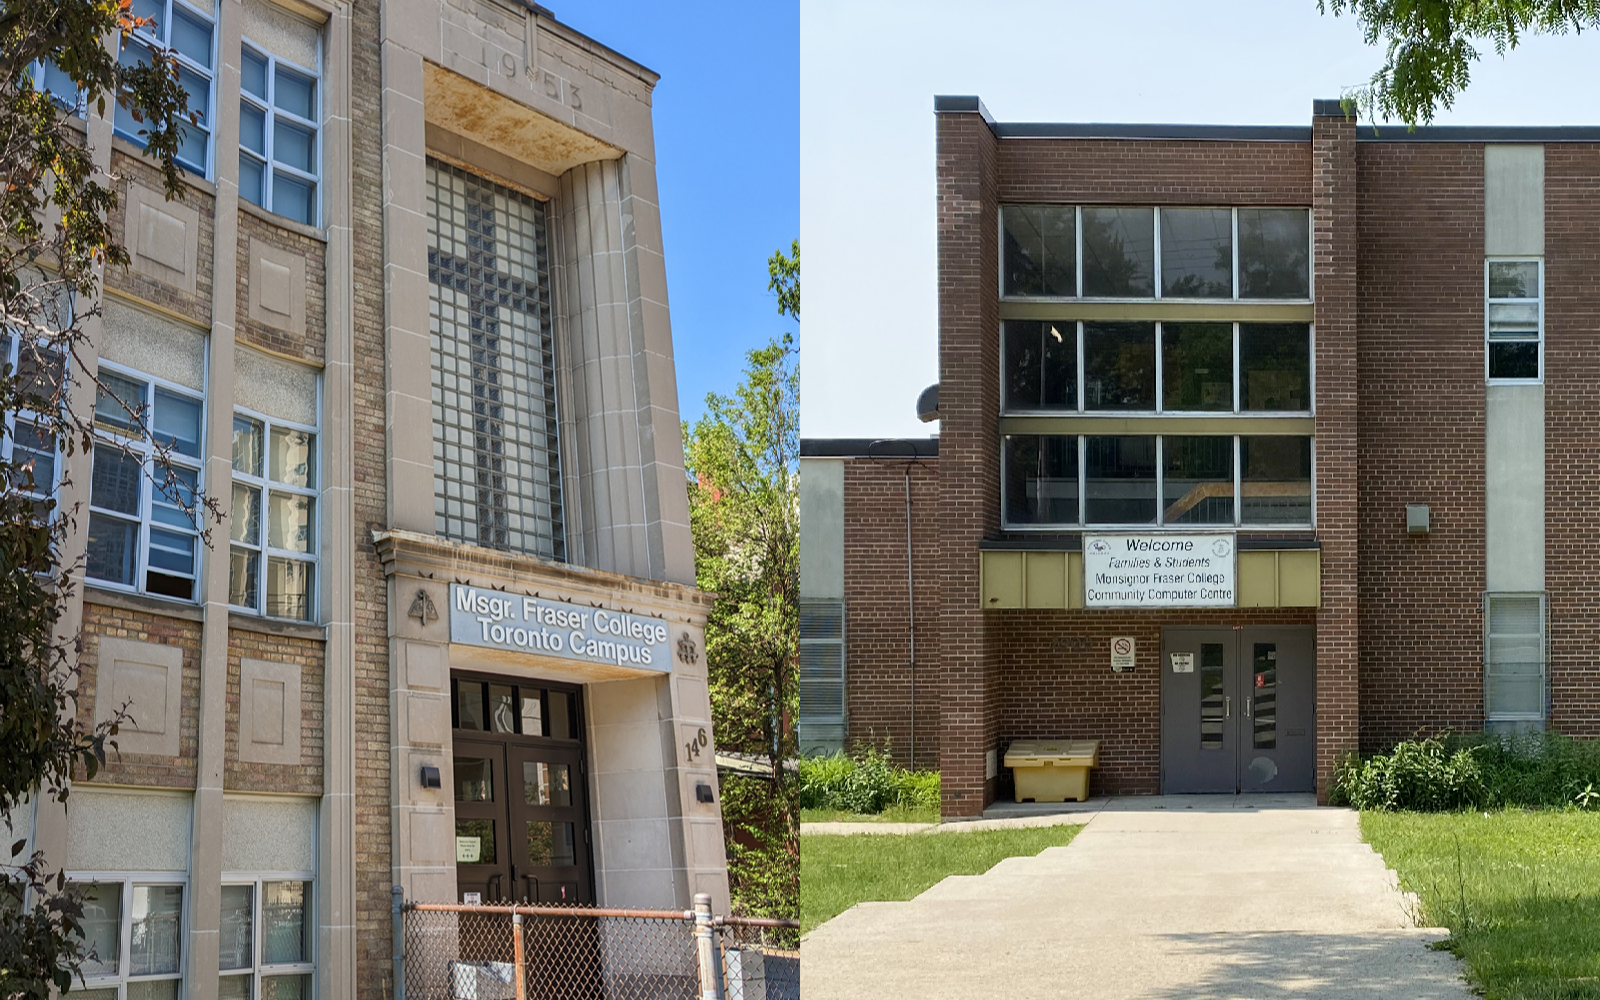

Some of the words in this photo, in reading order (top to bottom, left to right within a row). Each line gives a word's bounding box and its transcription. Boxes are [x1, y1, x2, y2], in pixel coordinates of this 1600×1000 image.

[480, 47, 582, 110] 1953
[1126, 538, 1194, 552] Welcome
[1108, 557, 1150, 568] Families
[1153, 557, 1162, 568] &
[1165, 556, 1211, 568] Students
[1095, 573, 1150, 587] Monsignor
[1153, 573, 1185, 584] Fraser
[1187, 572, 1225, 585] College
[1087, 588, 1146, 602] Community
[1148, 588, 1198, 602] Computer
[1200, 588, 1232, 600] Centre
[455, 586, 516, 622] Msgr.
[522, 596, 589, 631] Fraser
[593, 611, 668, 647] College
[476, 616, 564, 653] Toronto
[568, 630, 653, 667] Campus
[685, 727, 708, 763] 146
